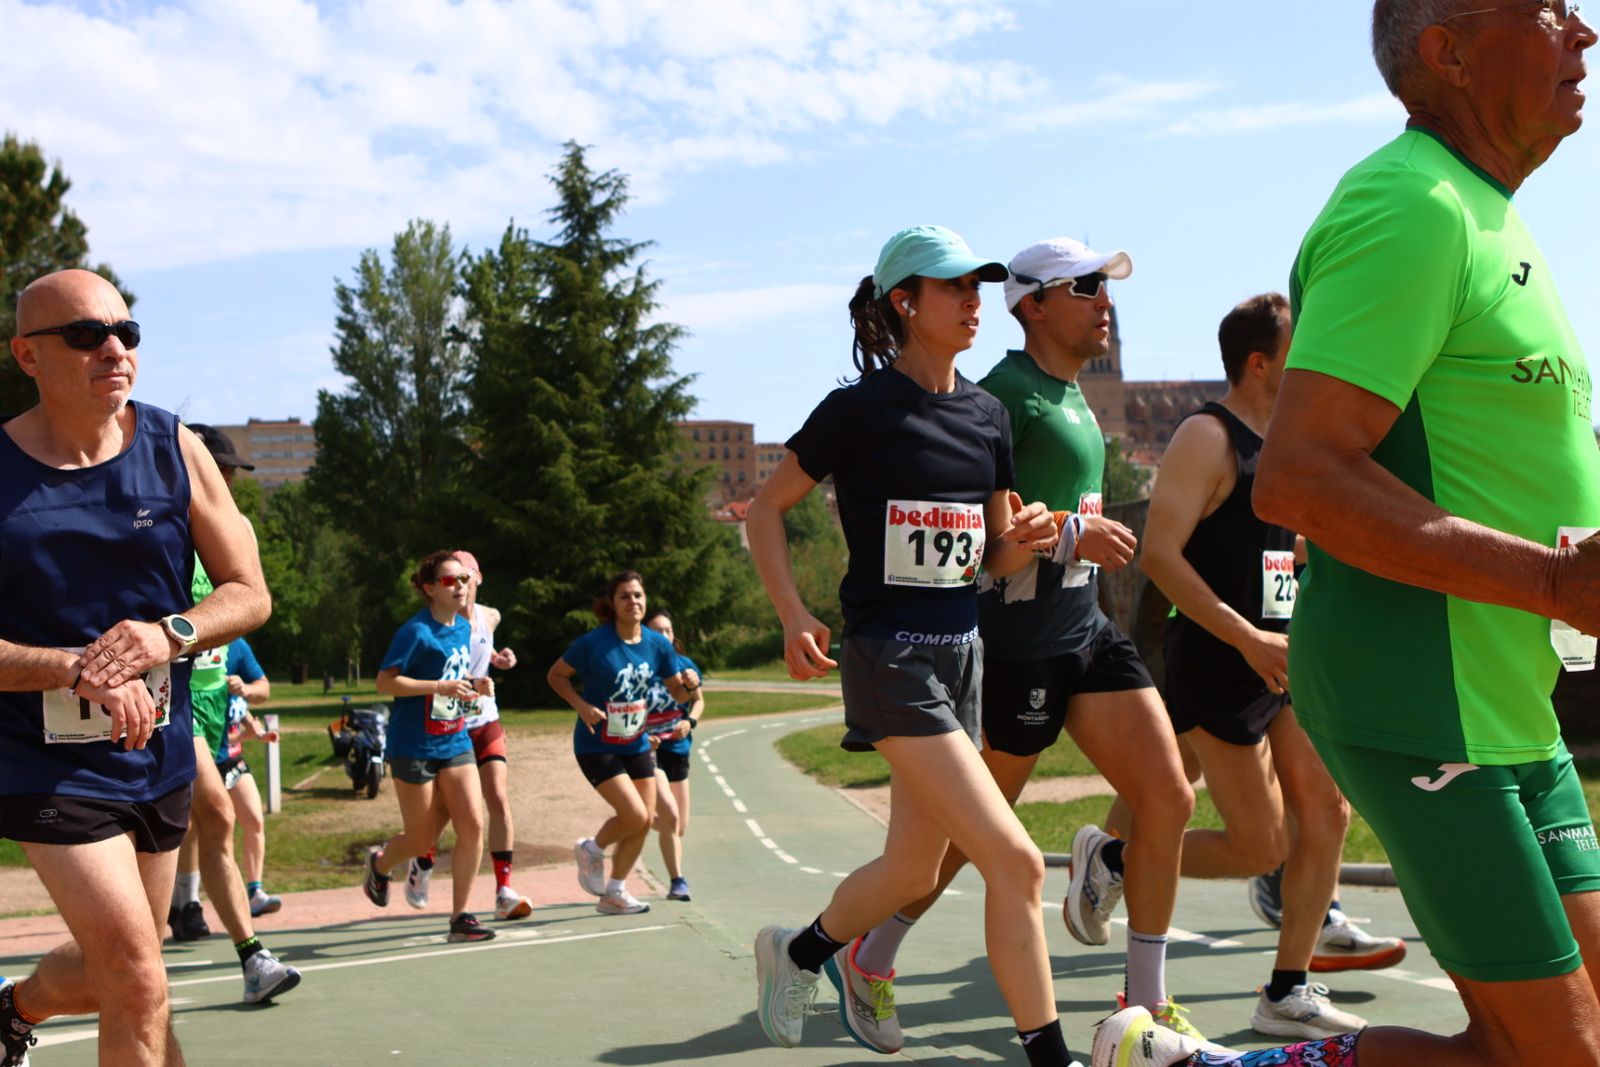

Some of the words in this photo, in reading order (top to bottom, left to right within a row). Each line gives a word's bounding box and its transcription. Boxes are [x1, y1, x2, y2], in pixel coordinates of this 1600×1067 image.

[889, 504, 983, 529] bedunia
[908, 529, 973, 568] 193
[1274, 573, 1295, 602] 22
[622, 713, 638, 728] 14
